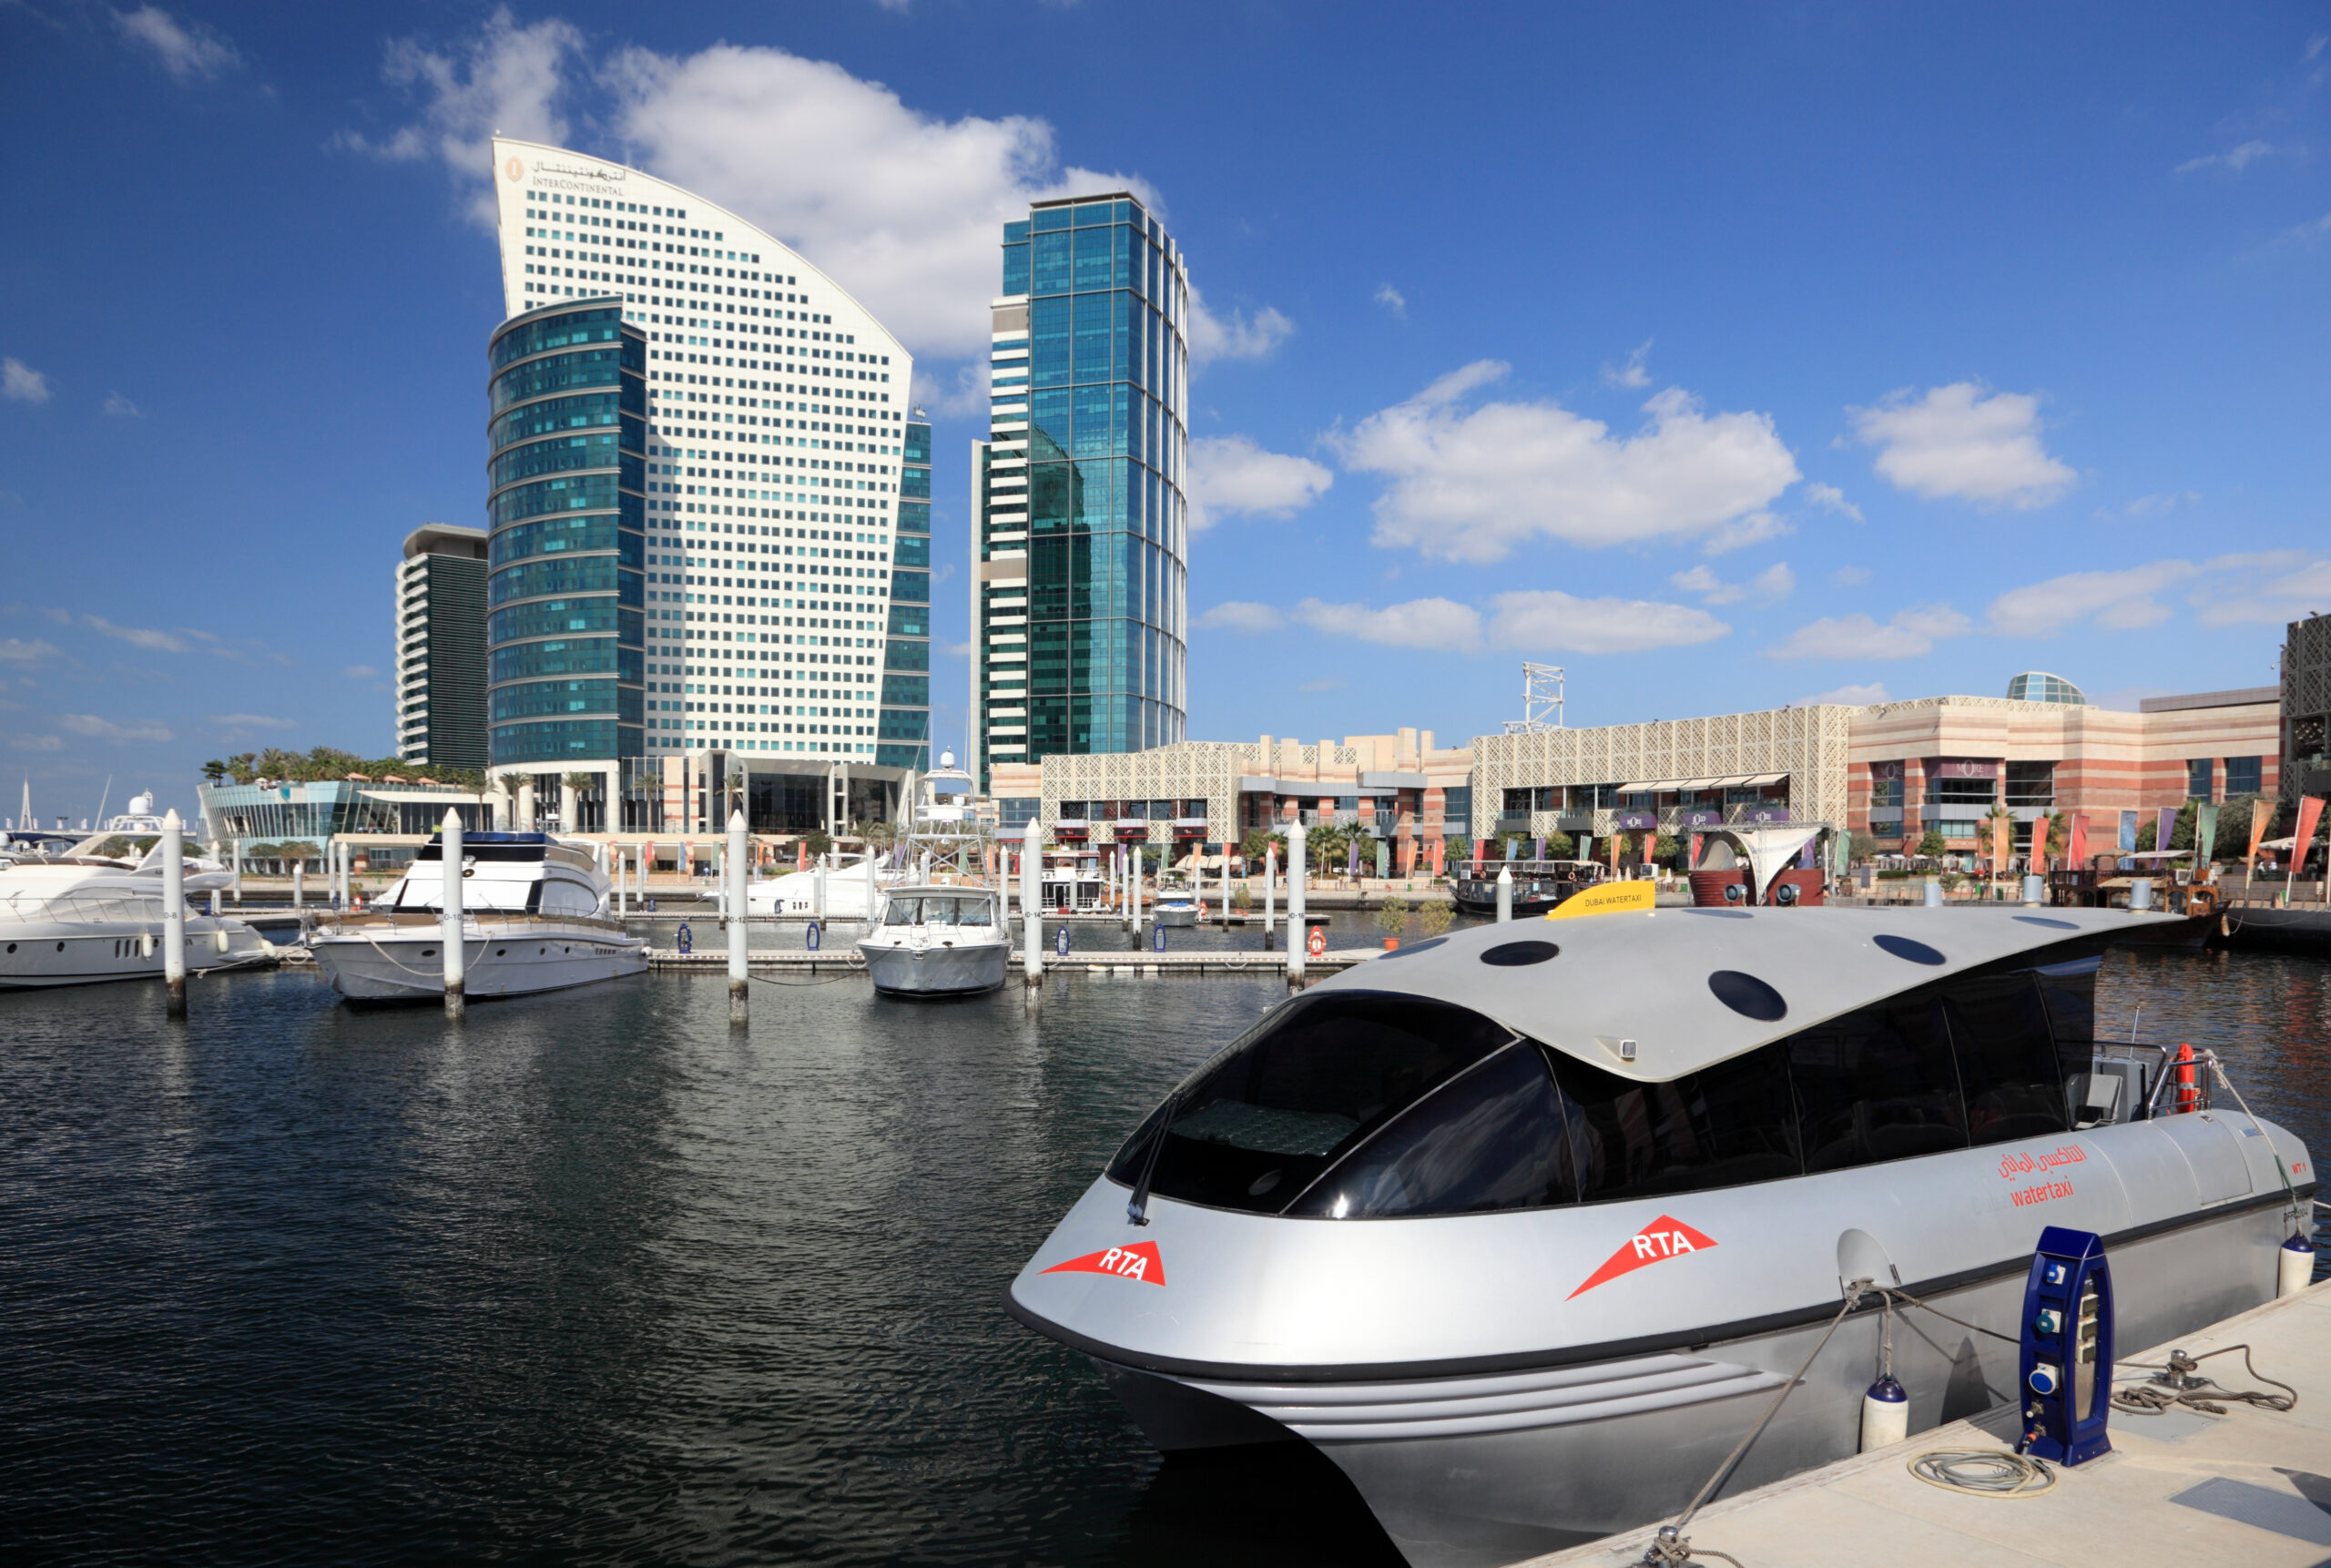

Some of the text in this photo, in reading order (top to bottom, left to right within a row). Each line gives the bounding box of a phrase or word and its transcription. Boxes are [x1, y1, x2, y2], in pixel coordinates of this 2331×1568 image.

[533, 176, 626, 197] INTERCONTINENTAL
[1957, 759, 1984, 777] MORE
[1585, 894, 1642, 907] DUBAI WATERTAXI
[1998, 1144, 2088, 1182] التاكسي المائي
[2292, 1162, 2307, 1175] WT 1
[2010, 1175, 2074, 1207] watertaxi
[1632, 1230, 1696, 1258] RTA
[1098, 1247, 1148, 1280] RTA
